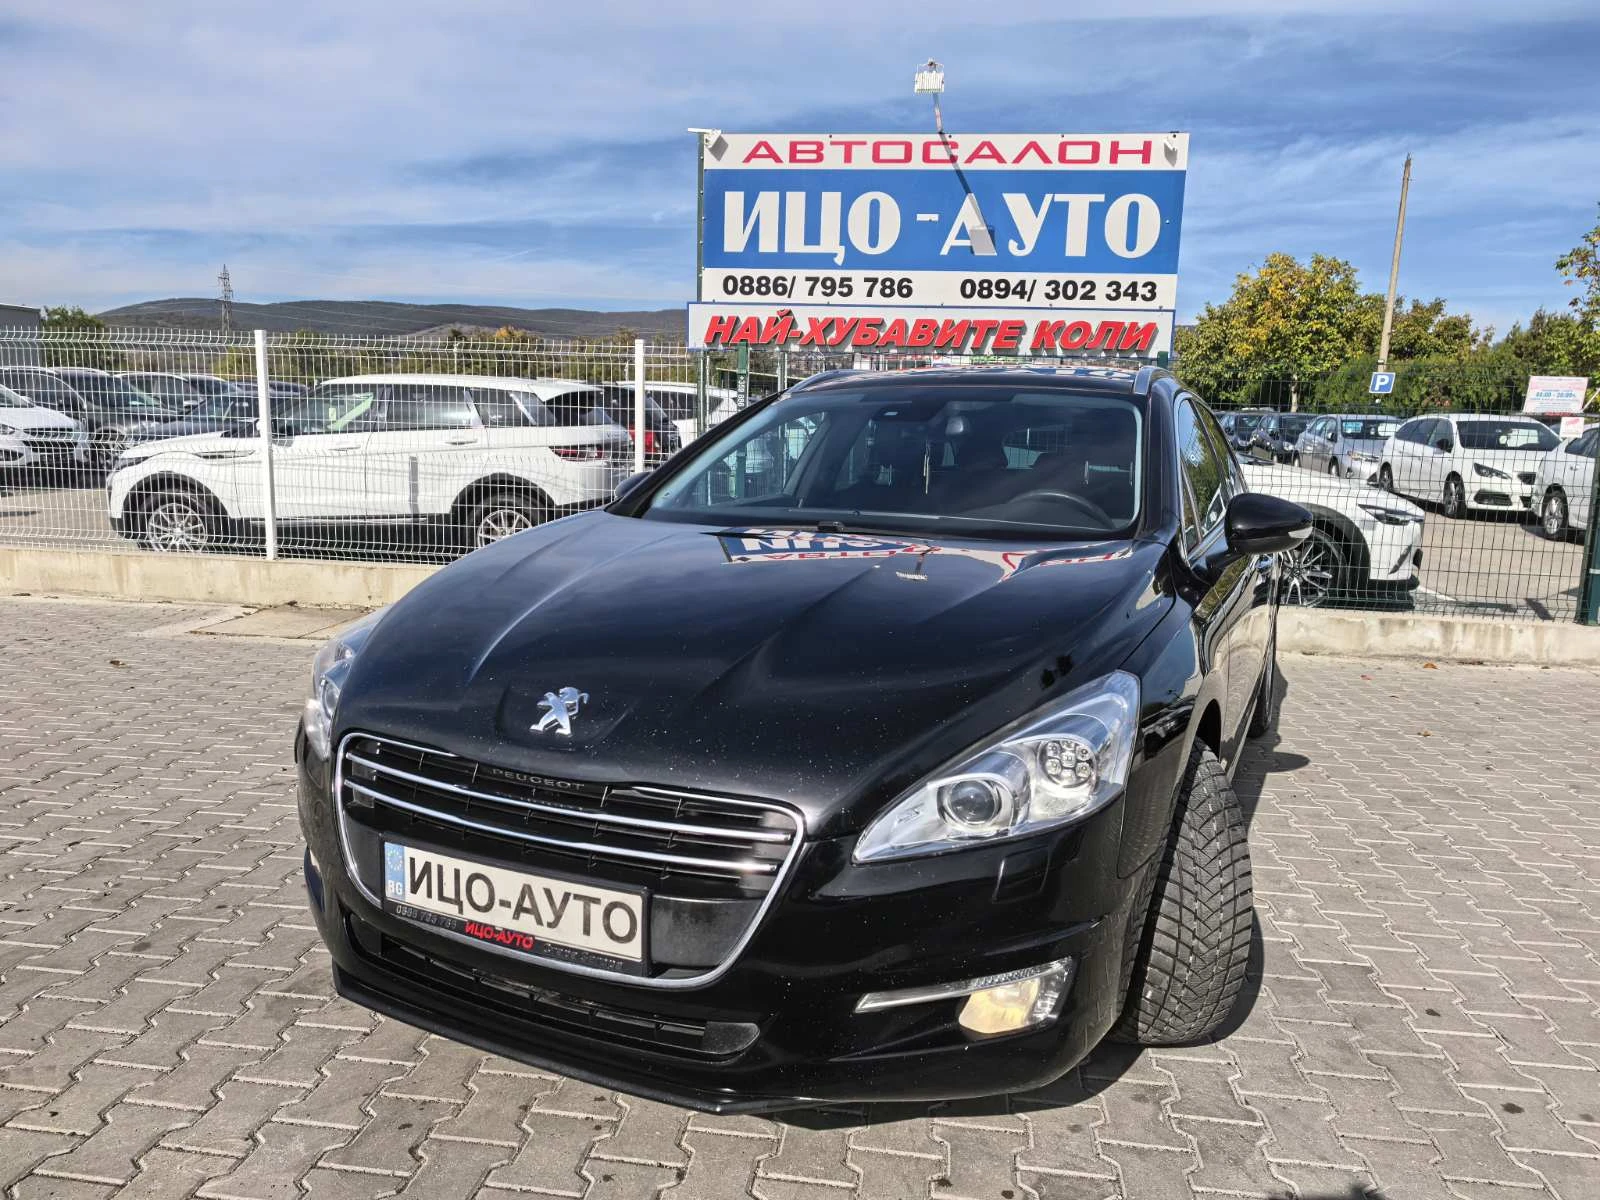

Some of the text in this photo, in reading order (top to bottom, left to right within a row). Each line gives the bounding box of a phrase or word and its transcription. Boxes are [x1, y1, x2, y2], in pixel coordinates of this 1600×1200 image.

[742, 140, 1151, 164] АВТОСАЛОН
[722, 274, 1157, 302] 0886/ 795 786 0894/ 302 343
[703, 309, 1158, 352] НАЙ-ХУБАВИТЕ КОЛИ
[1374, 374, 1390, 391] P
[492, 768, 585, 790] PEUGEOT
[409, 856, 638, 944] ИЦО-АУТО
[465, 920, 536, 949] ИЦО-АУТО
